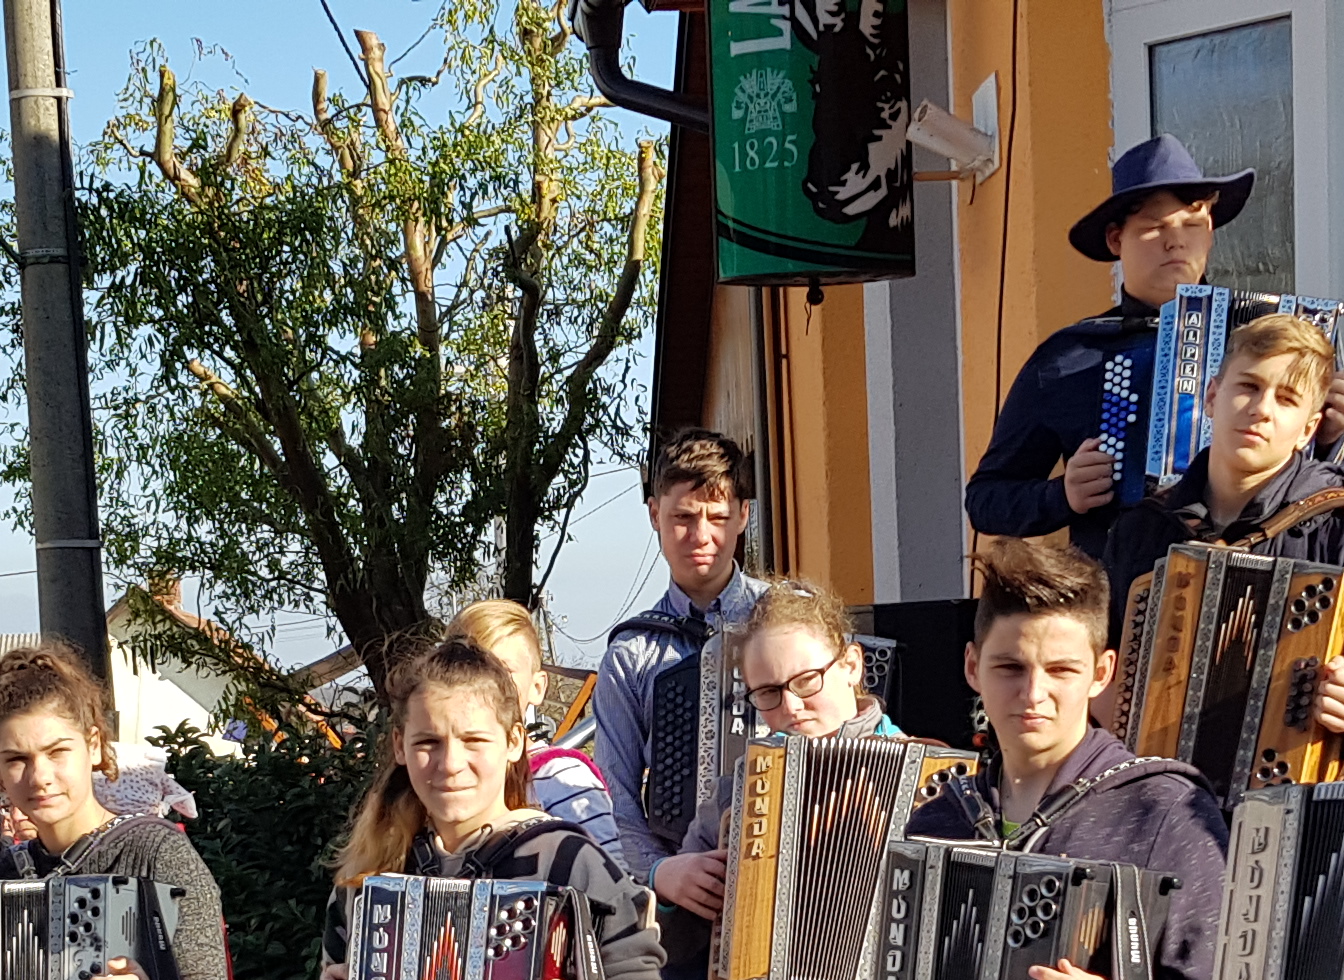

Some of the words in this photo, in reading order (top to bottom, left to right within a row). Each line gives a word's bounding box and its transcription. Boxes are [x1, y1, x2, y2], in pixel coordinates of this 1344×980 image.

[731, 133, 799, 172] 1825
[1181, 311, 1201, 393] ALPEN
[750, 755, 773, 859] MUNDA
